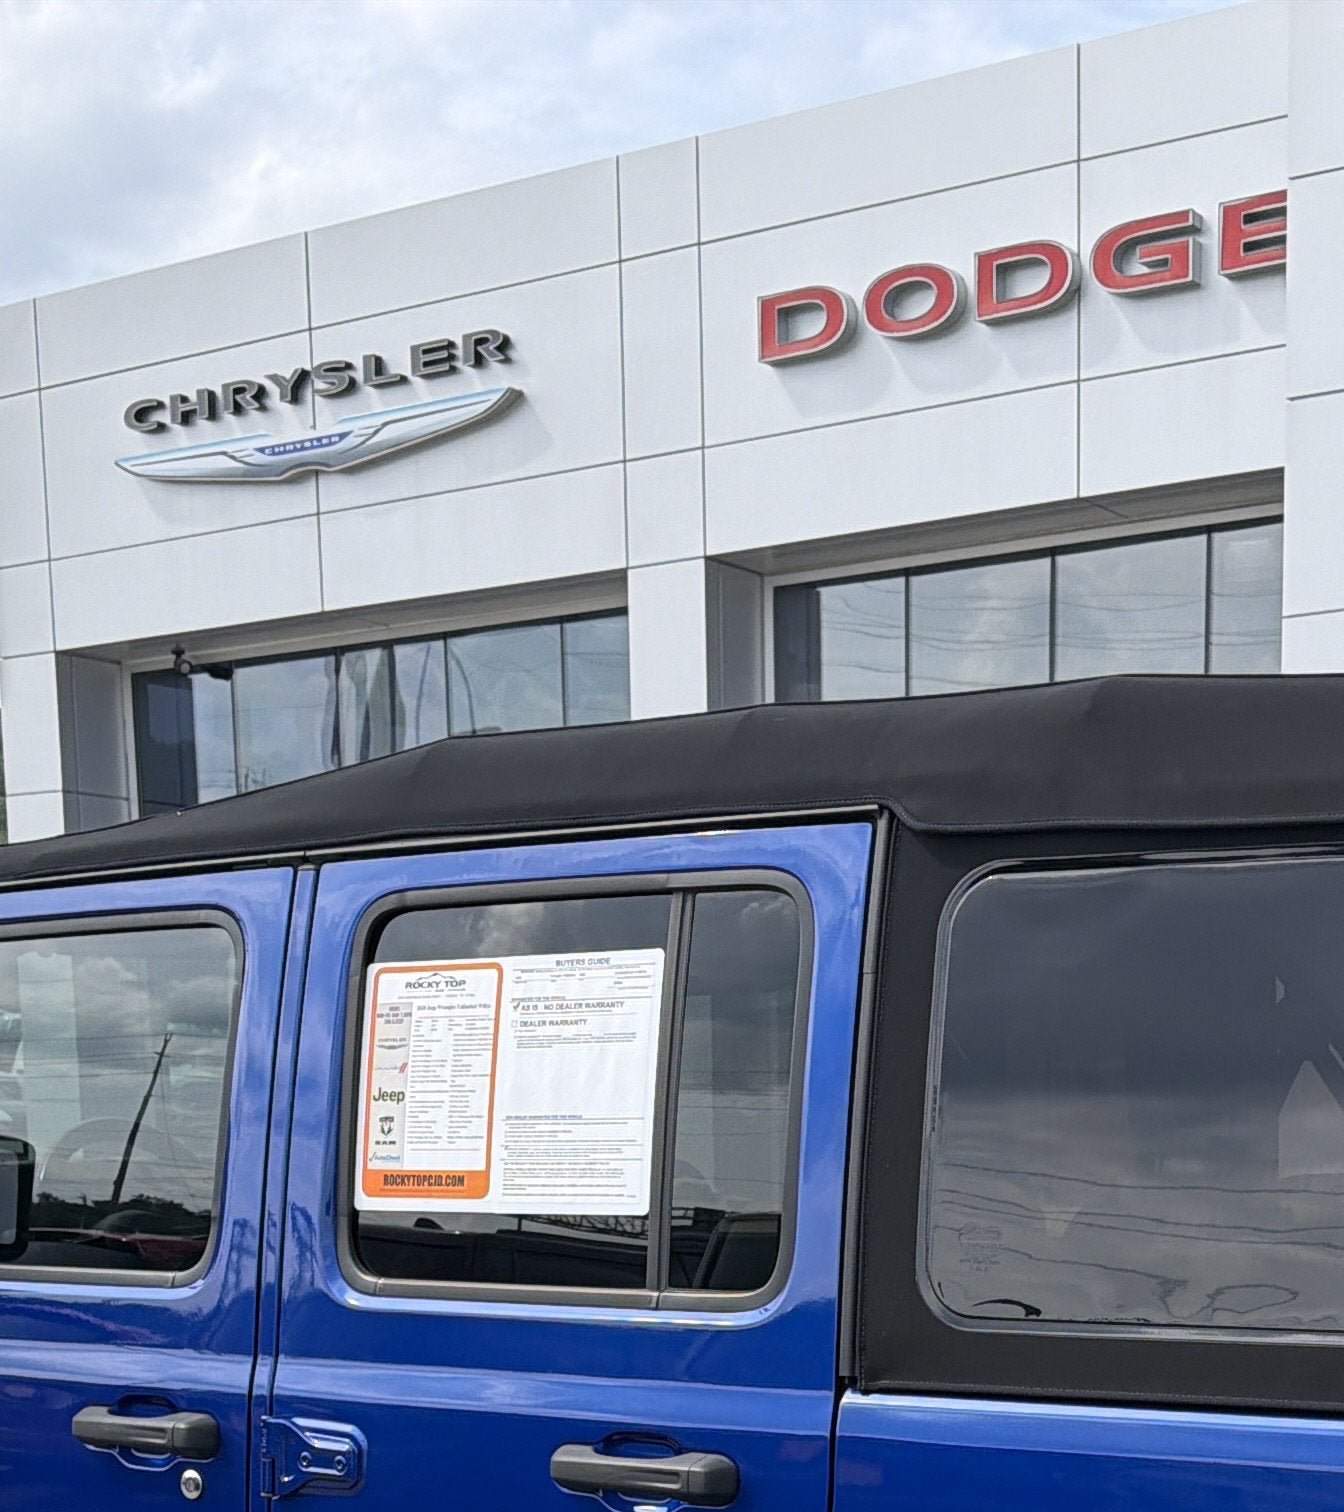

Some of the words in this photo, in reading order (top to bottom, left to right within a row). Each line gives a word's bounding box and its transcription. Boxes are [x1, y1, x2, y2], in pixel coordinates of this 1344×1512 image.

[758, 189, 1287, 364] DODGE
[123, 328, 512, 434] CHRYSLER
[263, 433, 342, 456] CHRYSLER
[555, 958, 586, 967] BUYERS
[587, 957, 611, 965] GUIDE
[405, 980, 442, 989] ROCKY
[444, 979, 467, 989] TOP
[543, 1003, 554, 1011] NO
[555, 1002, 583, 1010] DEALER
[584, 1001, 625, 1009] WARRANTY
[519, 1019, 547, 1028] DEALER
[549, 1018, 588, 1027] WARRANTY
[373, 1086, 406, 1105] Jeep
